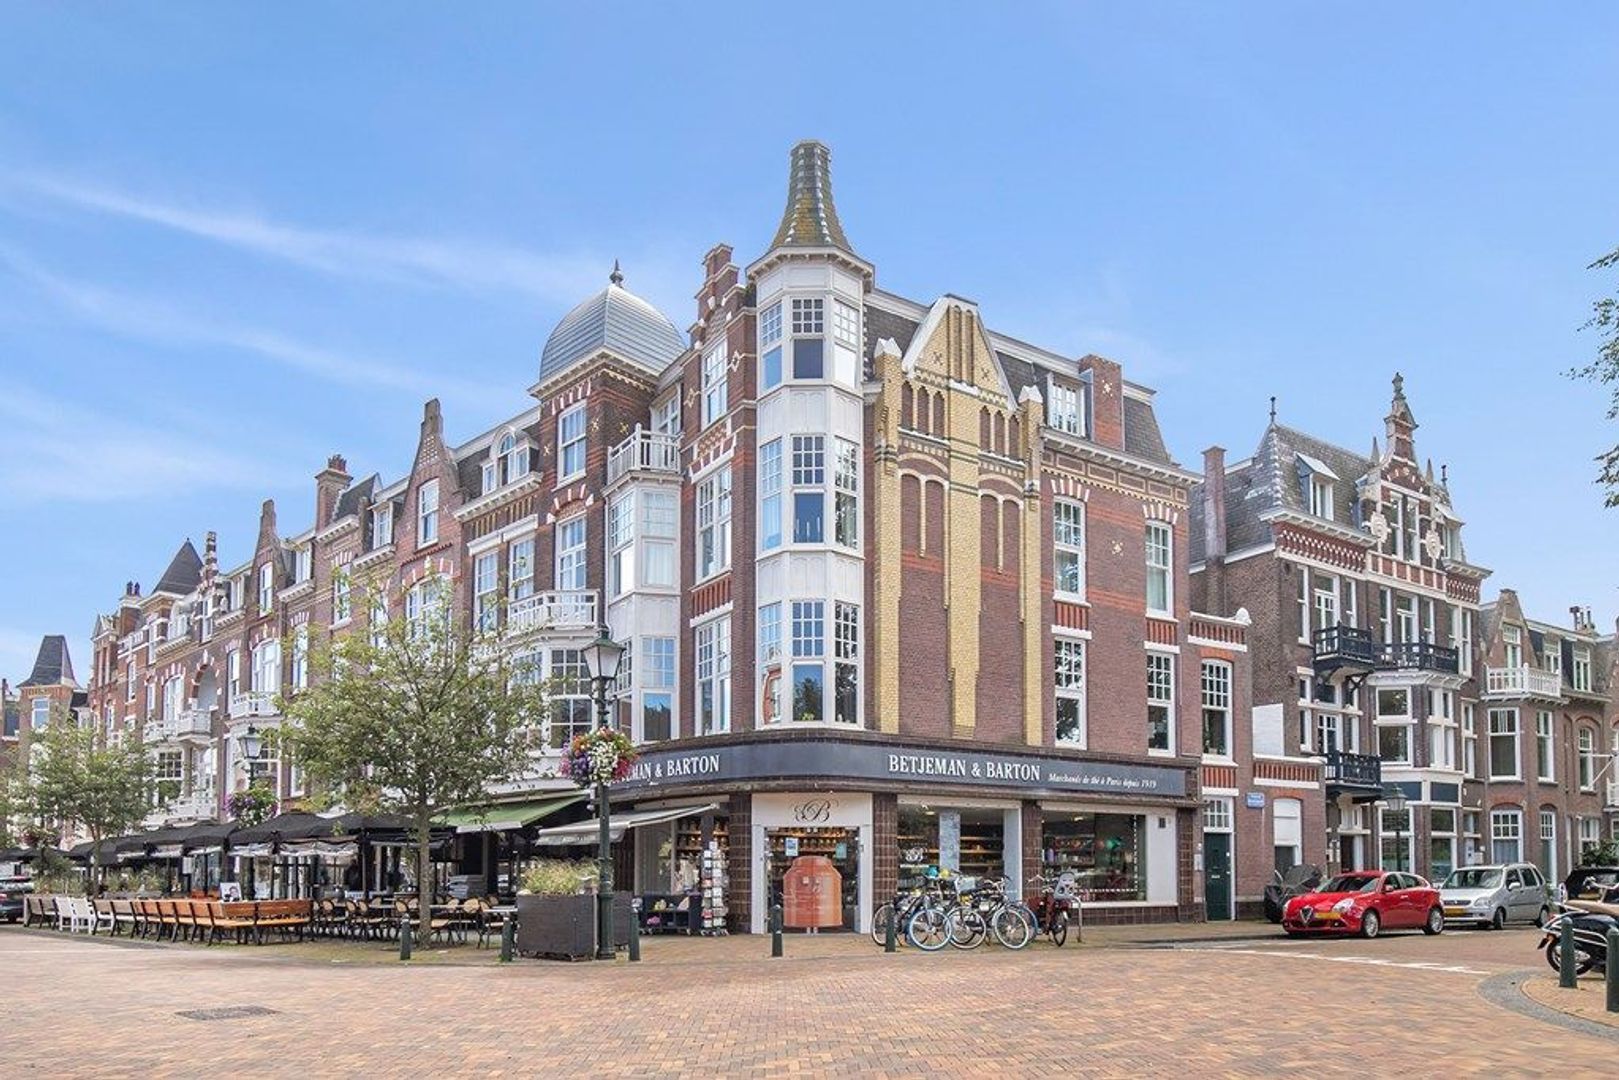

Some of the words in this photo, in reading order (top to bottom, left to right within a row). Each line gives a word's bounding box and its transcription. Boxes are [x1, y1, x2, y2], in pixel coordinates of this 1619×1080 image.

[655, 763, 662, 778] &
[666, 754, 720, 777] BARTON
[888, 754, 966, 776] BETJEMAN
[971, 762, 982, 777] &
[986, 762, 1040, 780] BARTON
